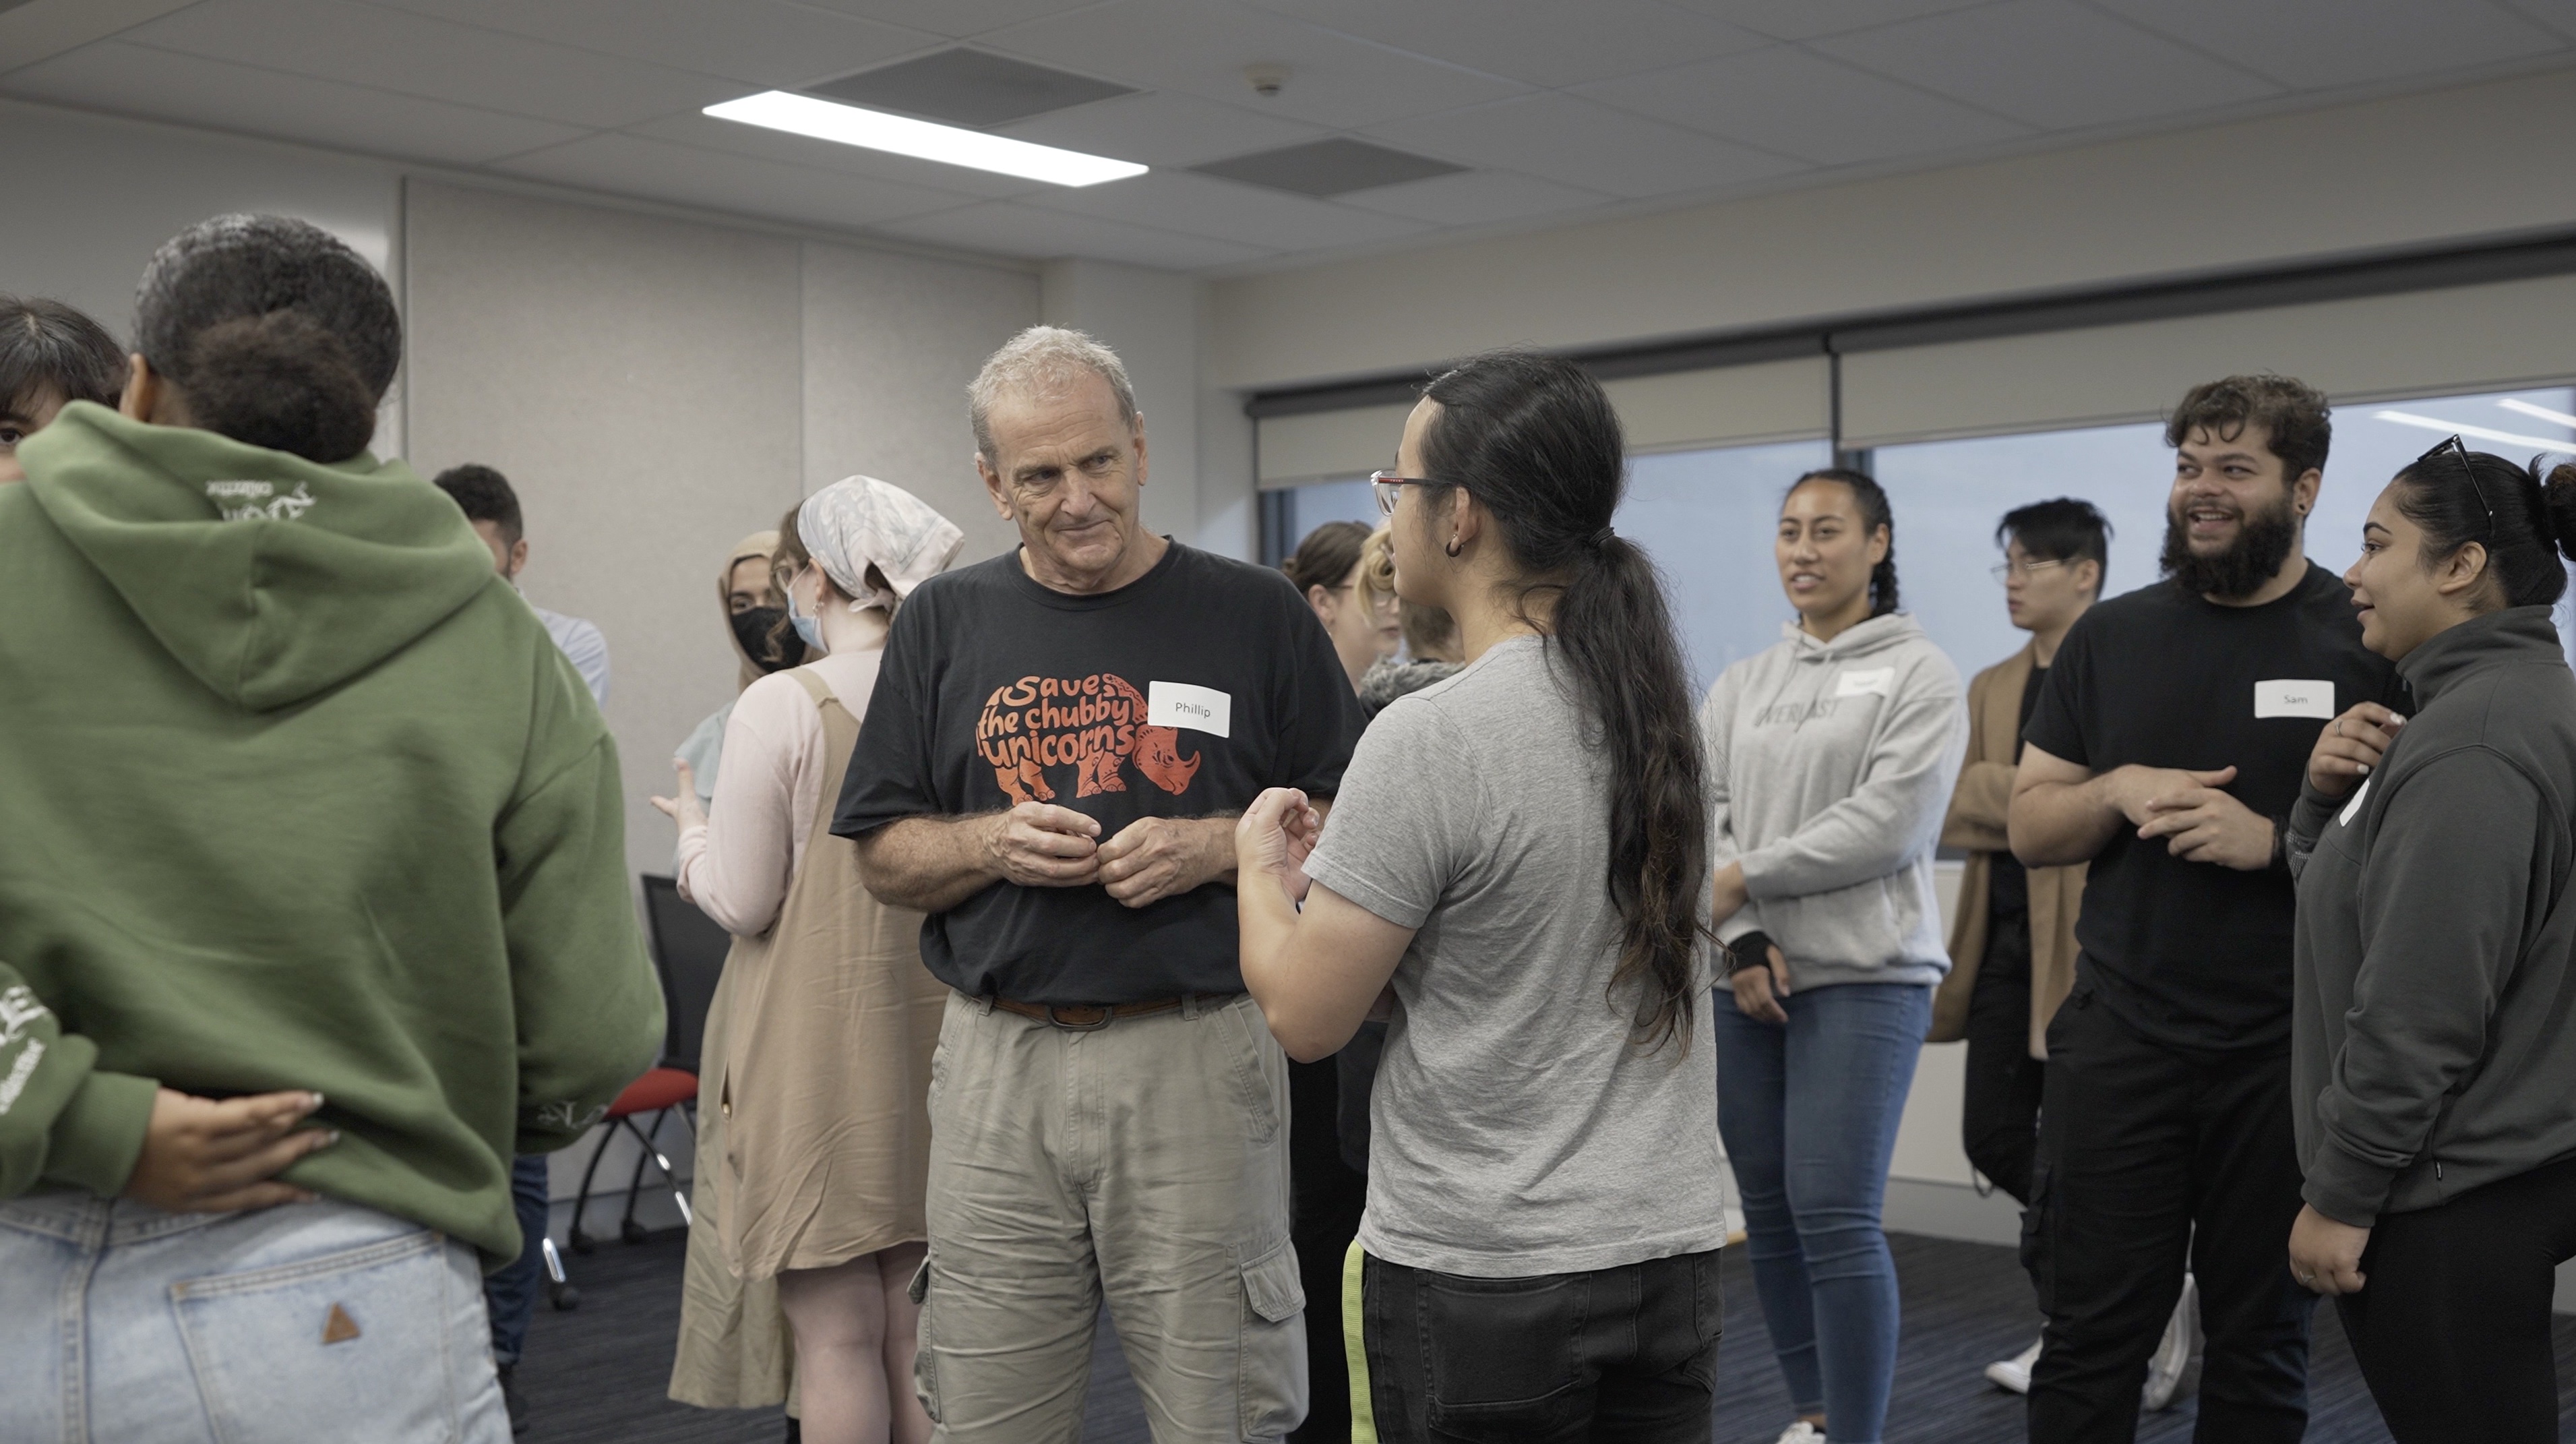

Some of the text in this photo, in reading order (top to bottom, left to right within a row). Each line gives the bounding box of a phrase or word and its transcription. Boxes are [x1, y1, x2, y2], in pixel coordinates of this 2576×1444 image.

[1002, 674, 1099, 706] Save
[2283, 694, 2308, 704] Sam
[979, 696, 1130, 740] the chubby
[1175, 702, 1210, 719] Phillip
[981, 724, 1136, 769] unicorns
